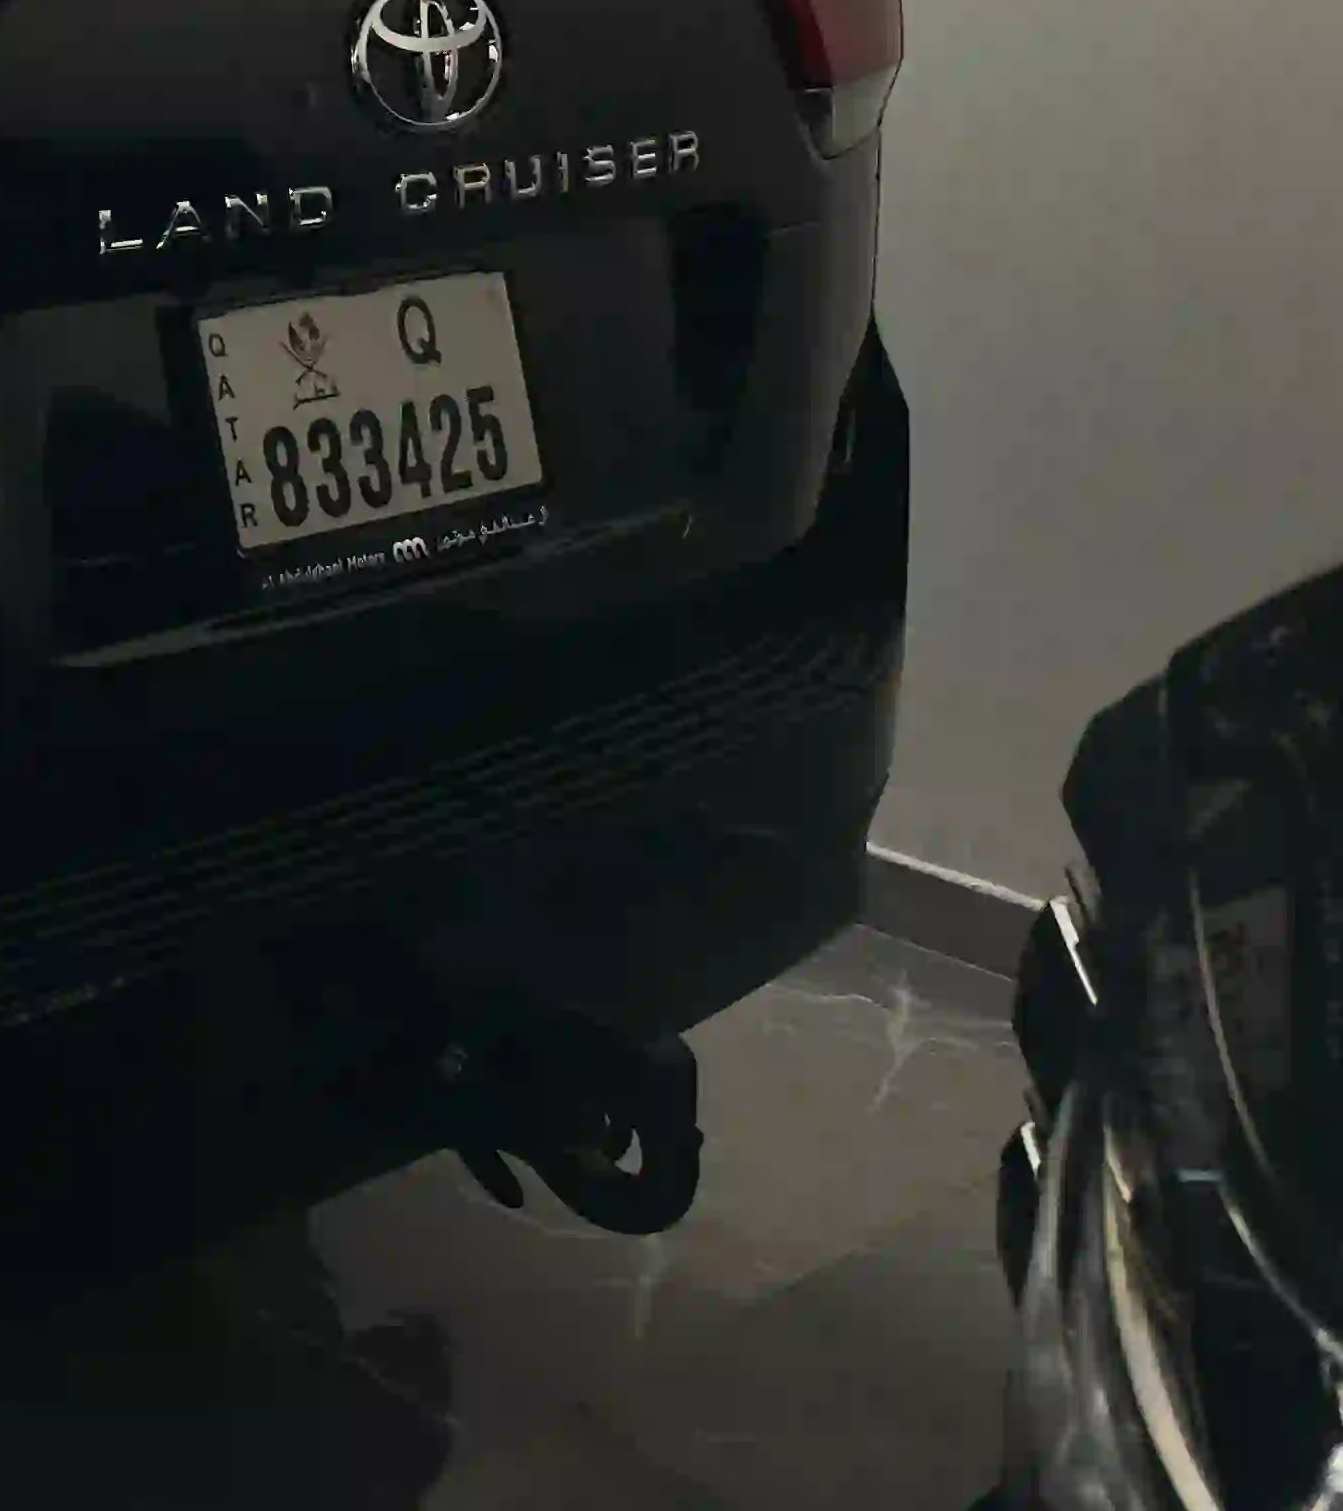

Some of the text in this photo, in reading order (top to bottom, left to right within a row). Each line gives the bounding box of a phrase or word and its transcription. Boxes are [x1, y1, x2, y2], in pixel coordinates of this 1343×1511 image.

[98, 130, 701, 255] LAND CRUISER
[396, 294, 443, 366] Q
[262, 385, 509, 529] 833425
